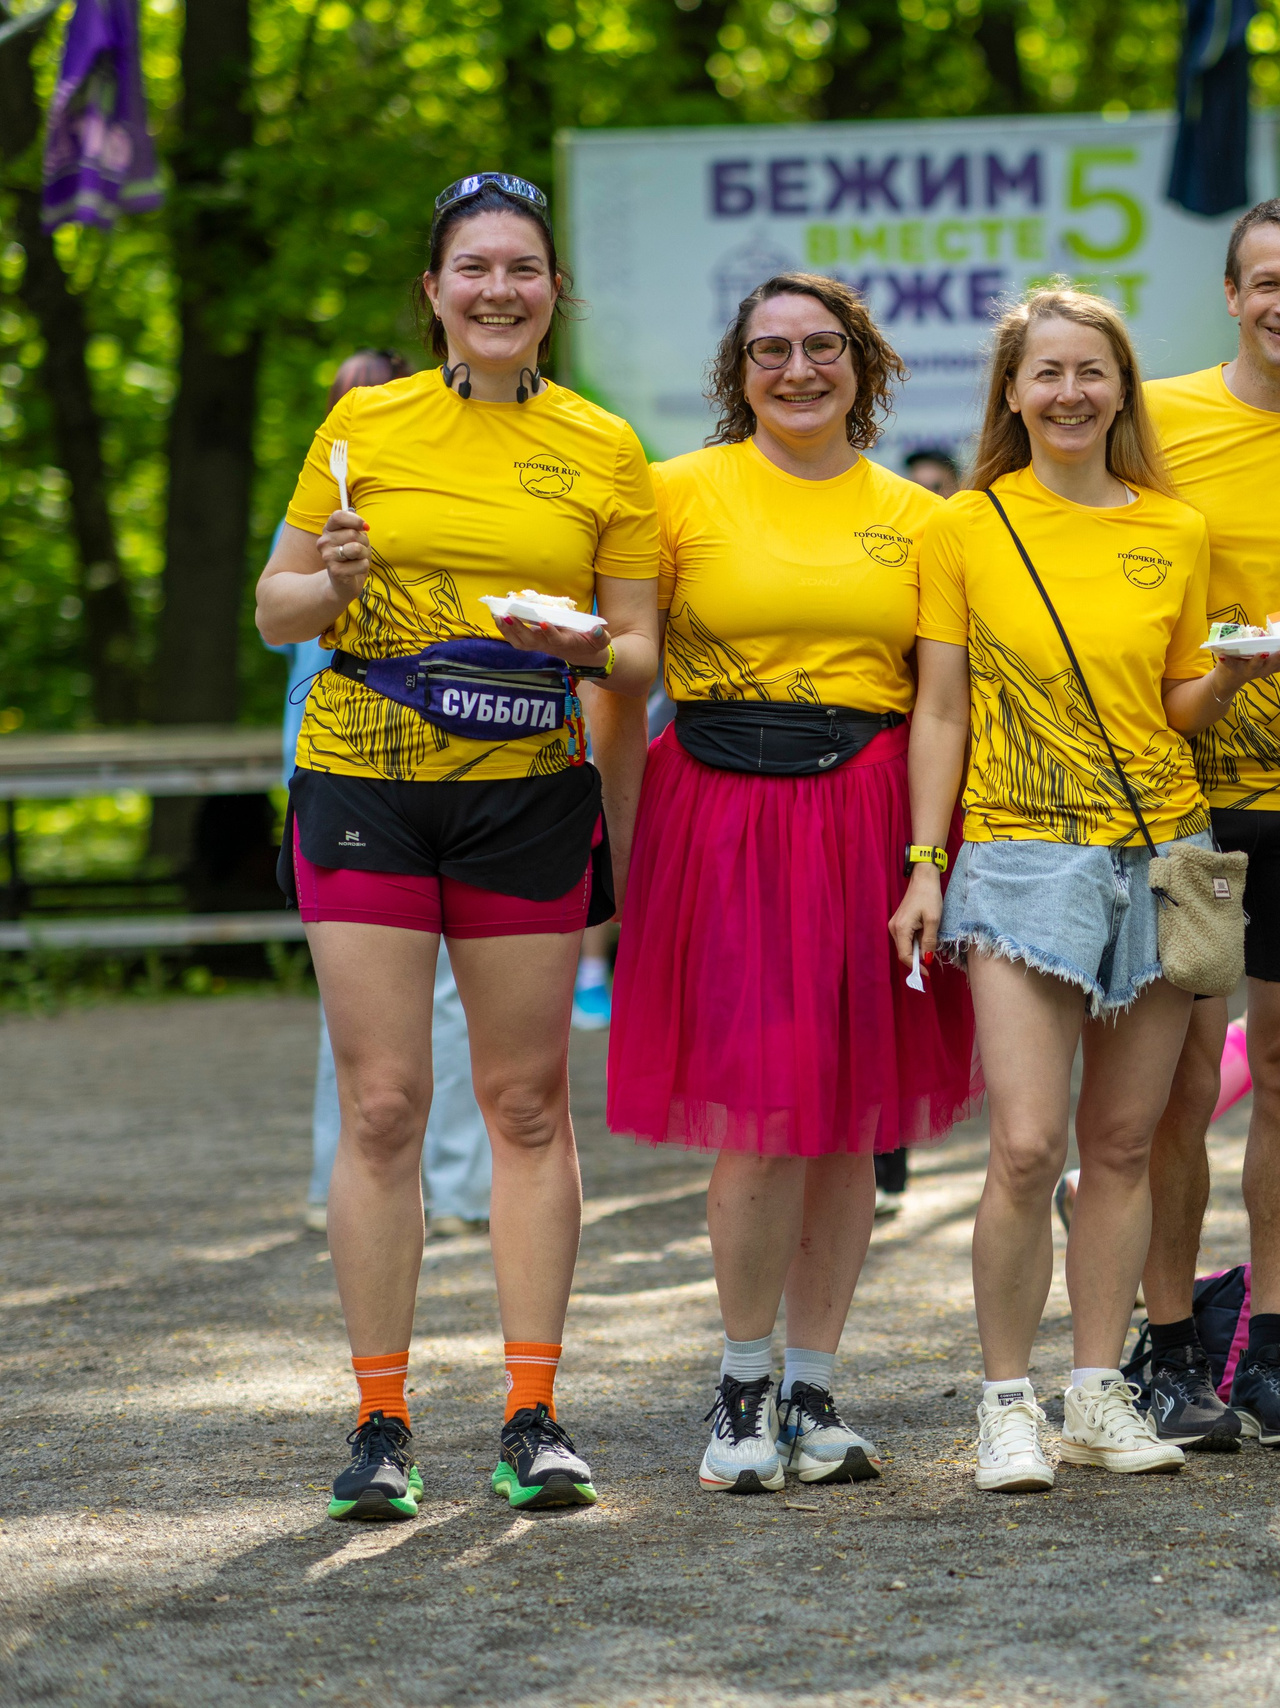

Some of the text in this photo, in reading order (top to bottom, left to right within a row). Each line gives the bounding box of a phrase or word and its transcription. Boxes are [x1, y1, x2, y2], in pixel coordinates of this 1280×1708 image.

[711, 151, 1045, 218] БЕЖИМ
[1062, 145, 1146, 264] 5
[805, 217, 1046, 268] ВМЕСТЕ
[513, 461, 581, 477] ГОРОЧКИ RUN
[853, 531, 914, 546] ГОРОЧКИ RUN
[1117, 552, 1173, 568] ГОРОЧКИ RUN
[442, 688, 557, 729] СУББОТА
